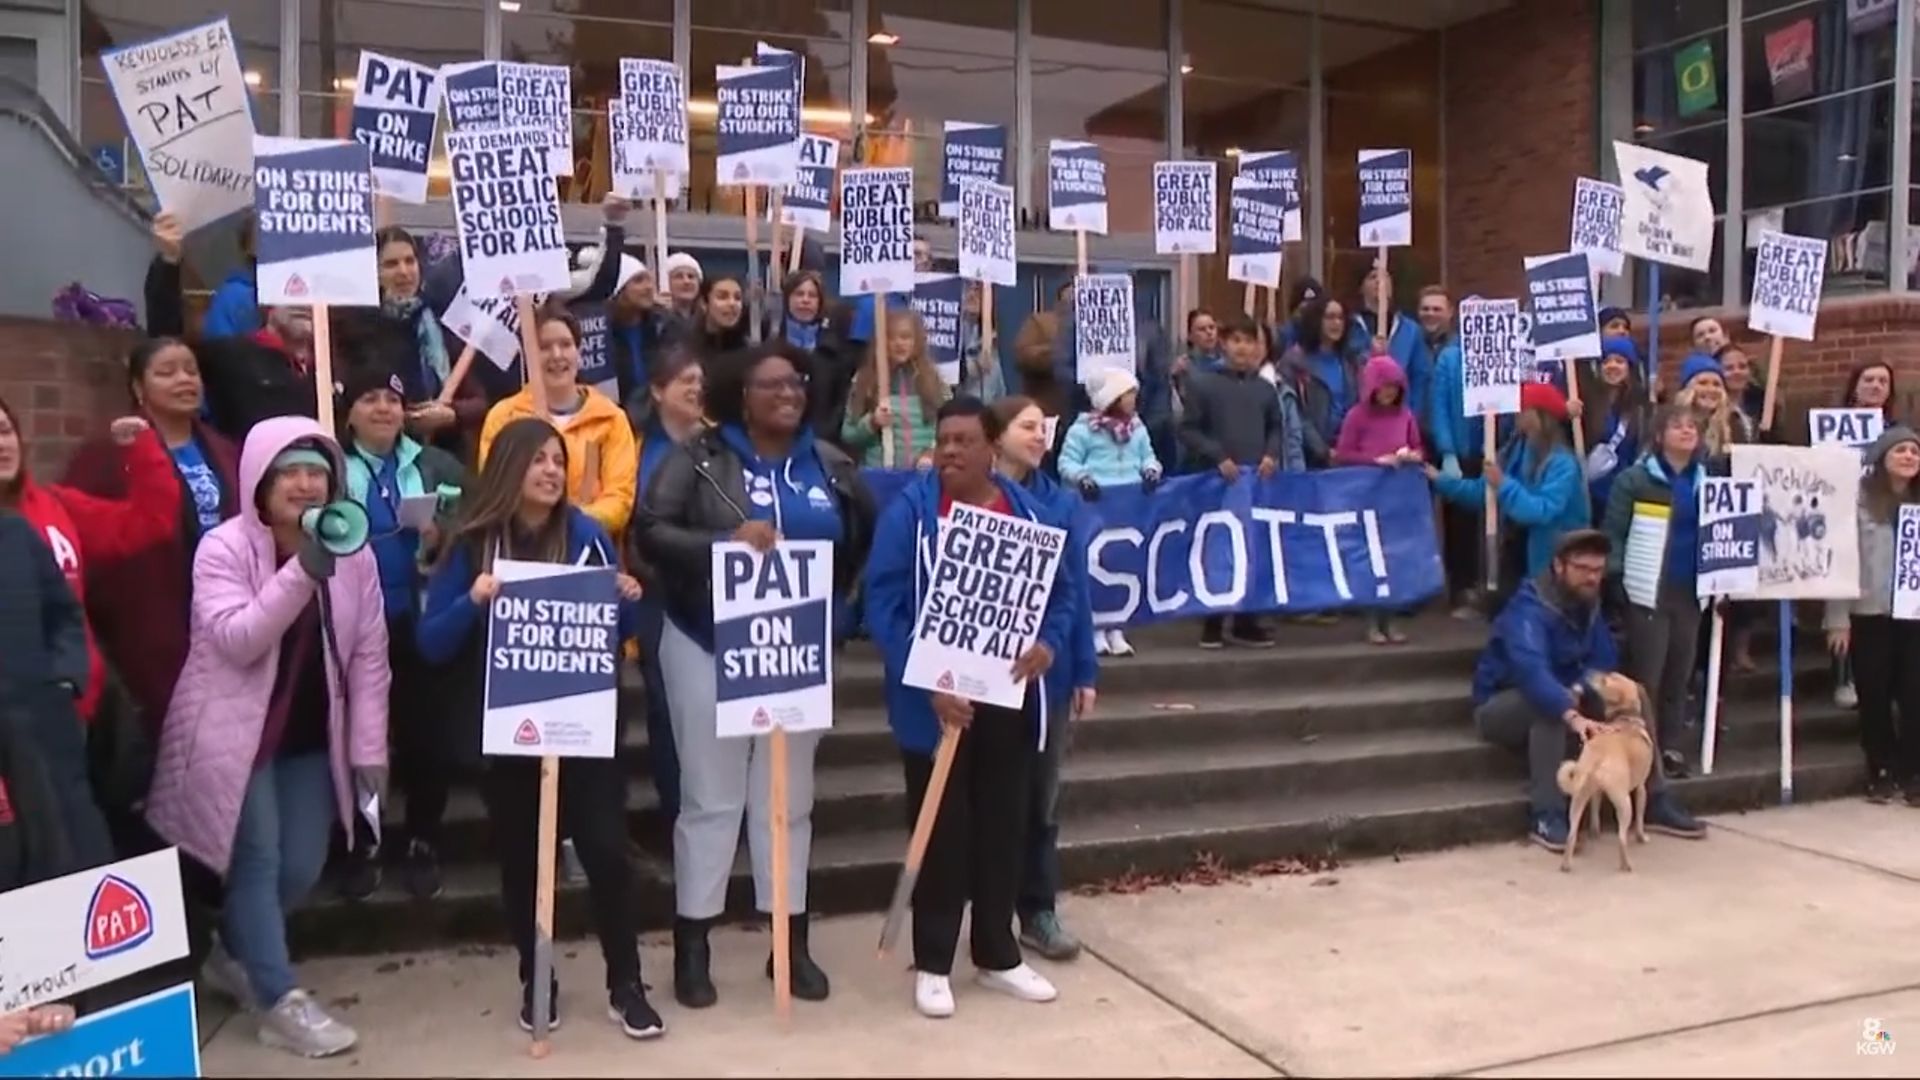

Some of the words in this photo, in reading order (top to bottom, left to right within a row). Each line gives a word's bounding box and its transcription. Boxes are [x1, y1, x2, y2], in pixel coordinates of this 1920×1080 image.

[207, 28, 229, 49] EA
[364, 59, 434, 108] PAT
[502, 76, 568, 99] GREAT
[625, 72, 681, 95] GREAT
[450, 88, 470, 103] ON
[625, 93, 681, 113] PUBLIC
[718, 88, 738, 102] ON
[741, 88, 792, 103] STRIKE
[138, 86, 222, 135] PAT
[502, 97, 569, 118] PUBLIC
[726, 103, 754, 117] FOR
[758, 104, 789, 118] OUR
[377, 112, 409, 136] ON
[626, 111, 683, 129] SCHOOLS
[720, 119, 793, 134] STUDENTS
[355, 128, 426, 164] STRIKE
[449, 134, 477, 151] PAT
[480, 130, 548, 149] DEMANDS
[627, 125, 658, 140] FOR
[662, 127, 684, 145] ALL
[800, 137, 832, 165] AT
[946, 143, 963, 156] ON
[964, 145, 1003, 160] STRIKE
[148, 150, 252, 191] SOLIDARIT
[452, 147, 550, 181] GREAT
[947, 158, 970, 171] FOR
[972, 160, 999, 173] SAFE
[256, 167, 286, 189] ON
[292, 170, 370, 193] STRIKE
[860, 170, 911, 183] DEMANDS
[1157, 173, 1211, 190] GREAT
[269, 193, 313, 212] FOR
[318, 193, 364, 213] OUR
[455, 177, 555, 212] PUBLIC
[786, 183, 829, 204] TRIKE
[843, 183, 911, 208] GREAT
[962, 189, 1011, 215] GREAT
[1157, 191, 1211, 206] PUBLIC
[461, 204, 559, 233] SCHOOLS
[843, 207, 911, 229] PUBLIC
[962, 208, 1011, 234] PUBLIC
[1158, 204, 1212, 219] SCHOOLS
[260, 213, 372, 235] STUDENTS
[1158, 217, 1185, 232] FOR
[1188, 217, 1212, 231] ALL
[466, 231, 516, 259] FOR
[523, 226, 563, 252] ALL
[843, 227, 912, 247] SCHOOLS
[843, 246, 874, 264] FOR
[878, 244, 912, 261] ALL
[962, 239, 986, 256] FOR
[991, 243, 1012, 261] ALL
[1760, 242, 1822, 268] GREAT
[1759, 260, 1819, 285] PUBLIC
[1078, 288, 1128, 307] GREAT
[1530, 280, 1547, 294] ON
[1758, 279, 1818, 299] SCHOOLS
[1536, 295, 1556, 308] FOR
[1754, 287, 1781, 309] FOR
[1785, 297, 1814, 314] ALL
[1078, 306, 1129, 324] PUBLIC
[1463, 314, 1516, 335] GREAT
[1536, 308, 1587, 325] SCHOOLS
[580, 334, 607, 350] AFE
[1079, 338, 1104, 354] FOR
[1108, 337, 1130, 354] ALL
[1464, 335, 1516, 354] PUBLIC
[1465, 352, 1517, 370] SCHOOLS
[1465, 369, 1490, 388] FOR
[1493, 367, 1517, 385] ALL
[1817, 414, 1874, 440] PAT
[1704, 482, 1754, 513] PAT
[952, 508, 985, 530] PAT
[987, 518, 1061, 549] DEMANDS
[1712, 523, 1733, 539] ON
[944, 527, 1055, 581] GREAT
[1702, 541, 1754, 560] STRIKE
[724, 550, 816, 601] PAT
[1087, 509, 1391, 624] SCOTT!
[934, 559, 1045, 612] PUBLIC
[1898, 574, 1920, 591] FO
[495, 597, 531, 620] ON
[535, 600, 617, 626] STRIKE
[928, 590, 1037, 636] SCHOOLS
[507, 623, 558, 647] FOR
[563, 625, 608, 649] OUR
[750, 616, 792, 645] ON
[919, 614, 979, 652] FOR
[982, 631, 1025, 662] ALL
[494, 648, 615, 674] STUDENTS
[723, 645, 819, 680] STRIKE
[96, 902, 139, 944] PAT
